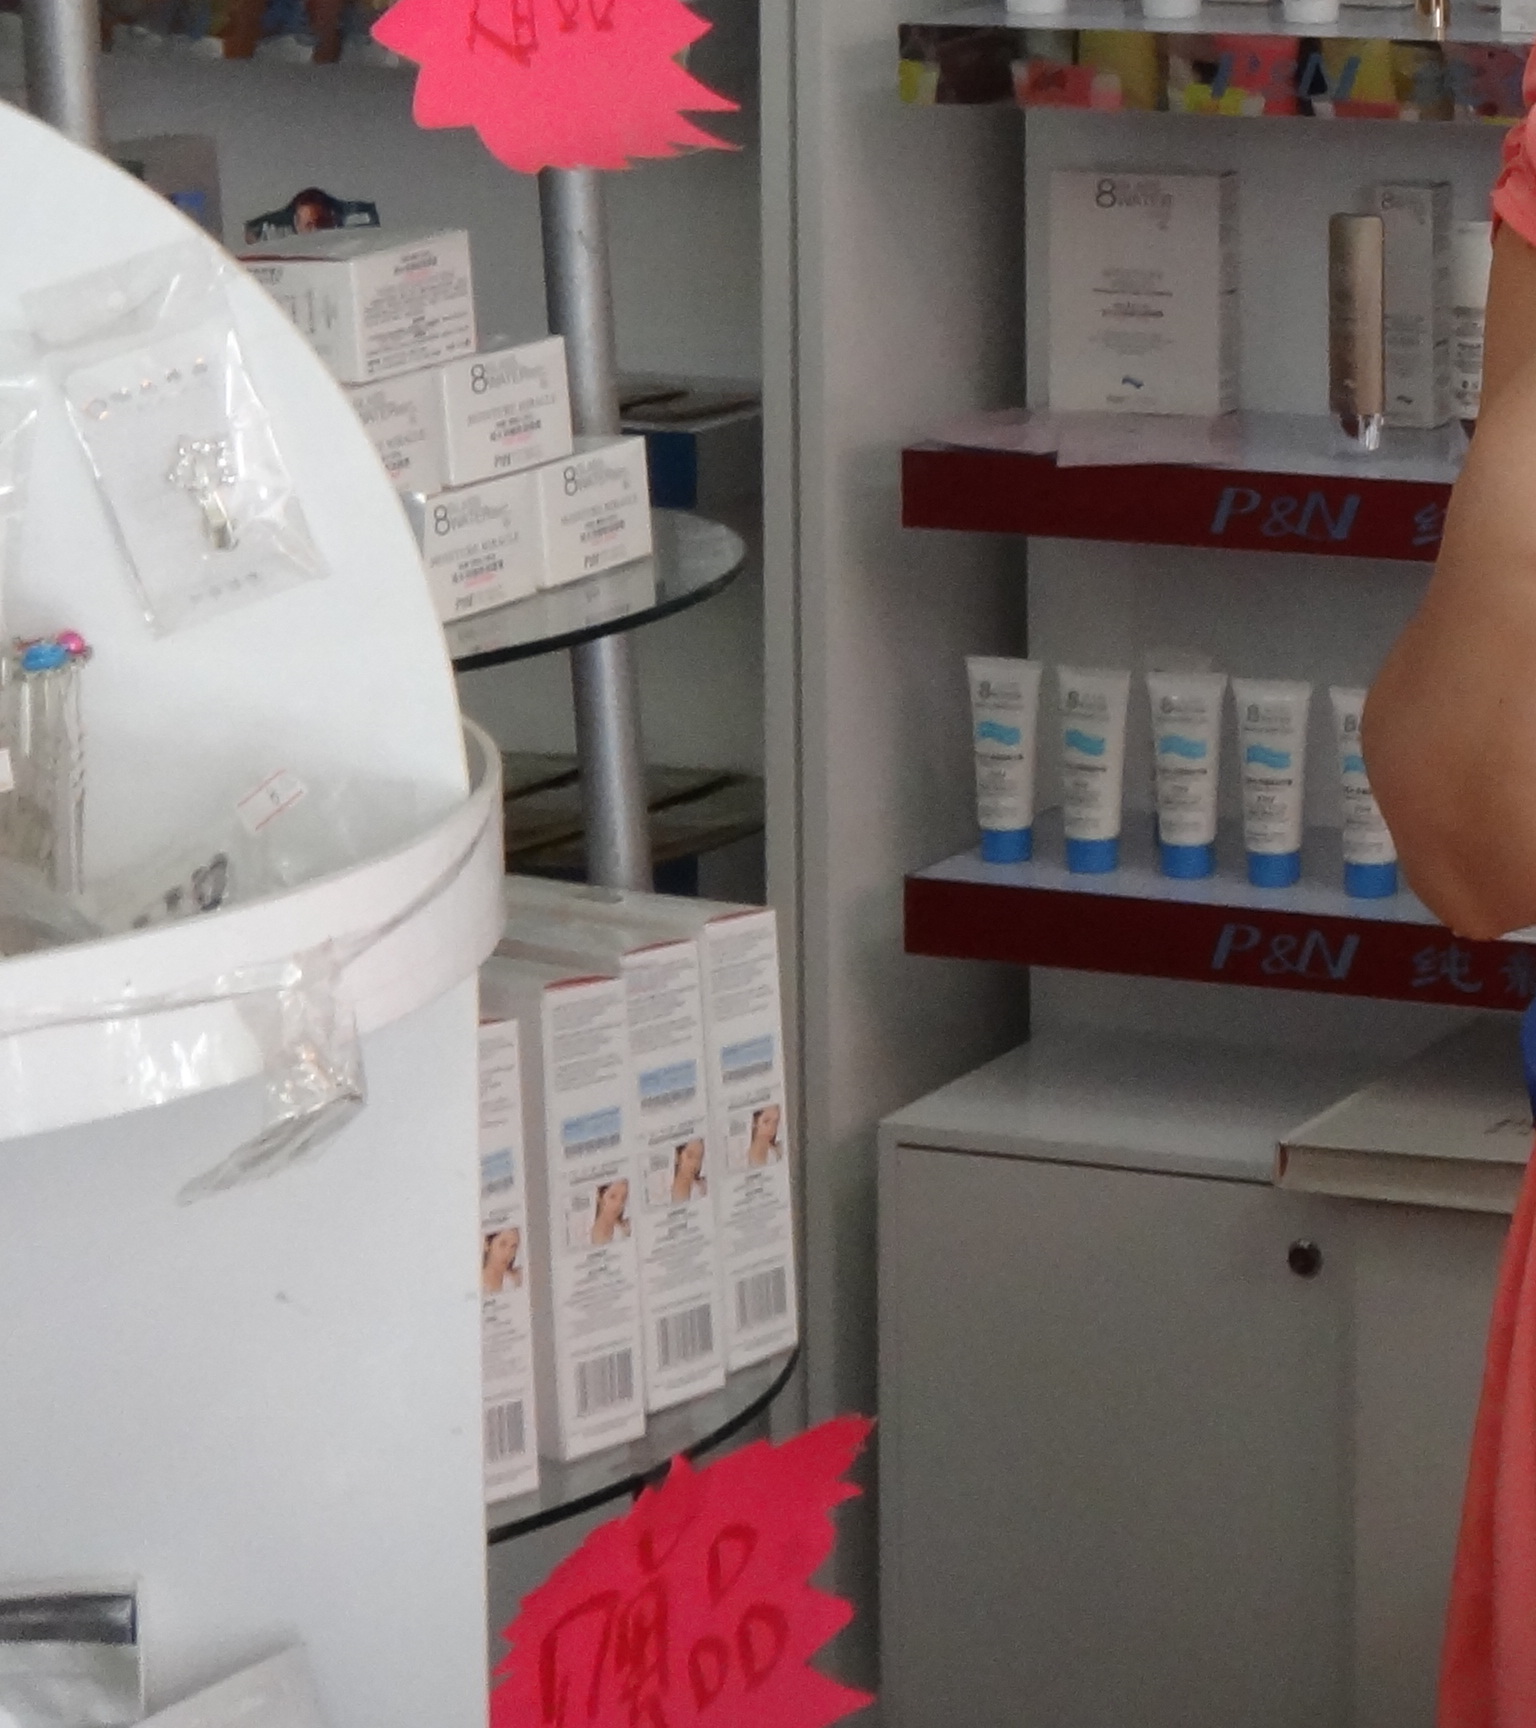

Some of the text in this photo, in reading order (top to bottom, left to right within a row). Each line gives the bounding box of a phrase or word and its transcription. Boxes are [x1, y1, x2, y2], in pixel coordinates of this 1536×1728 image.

[470, 363, 488, 394] 8
[563, 465, 578, 497] 8
[433, 504, 451, 536] 8
[1210, 485, 1361, 541] P&N
[1210, 922, 1361, 981] P&N
